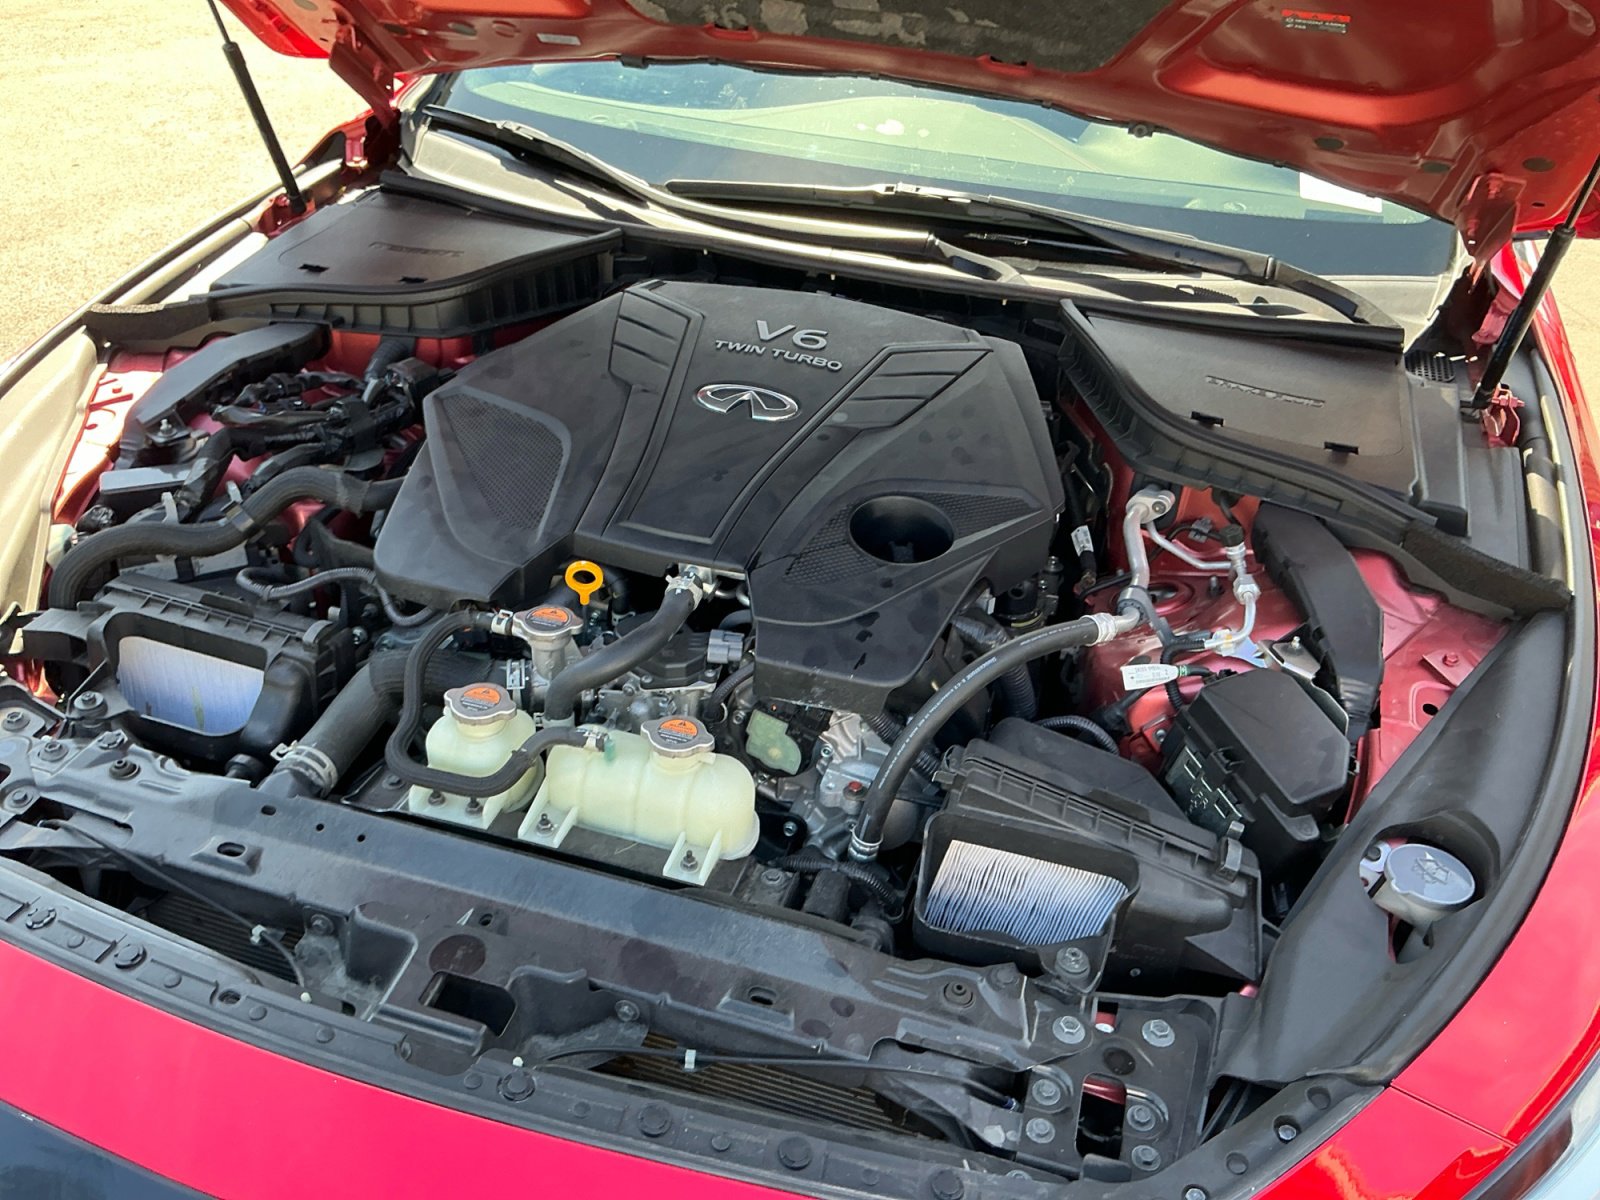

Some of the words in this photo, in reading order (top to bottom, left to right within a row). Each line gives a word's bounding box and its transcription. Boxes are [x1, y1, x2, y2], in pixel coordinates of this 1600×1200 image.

[756, 319, 828, 350] V6
[715, 339, 766, 355] TWIN
[772, 348, 843, 372] TURBO
